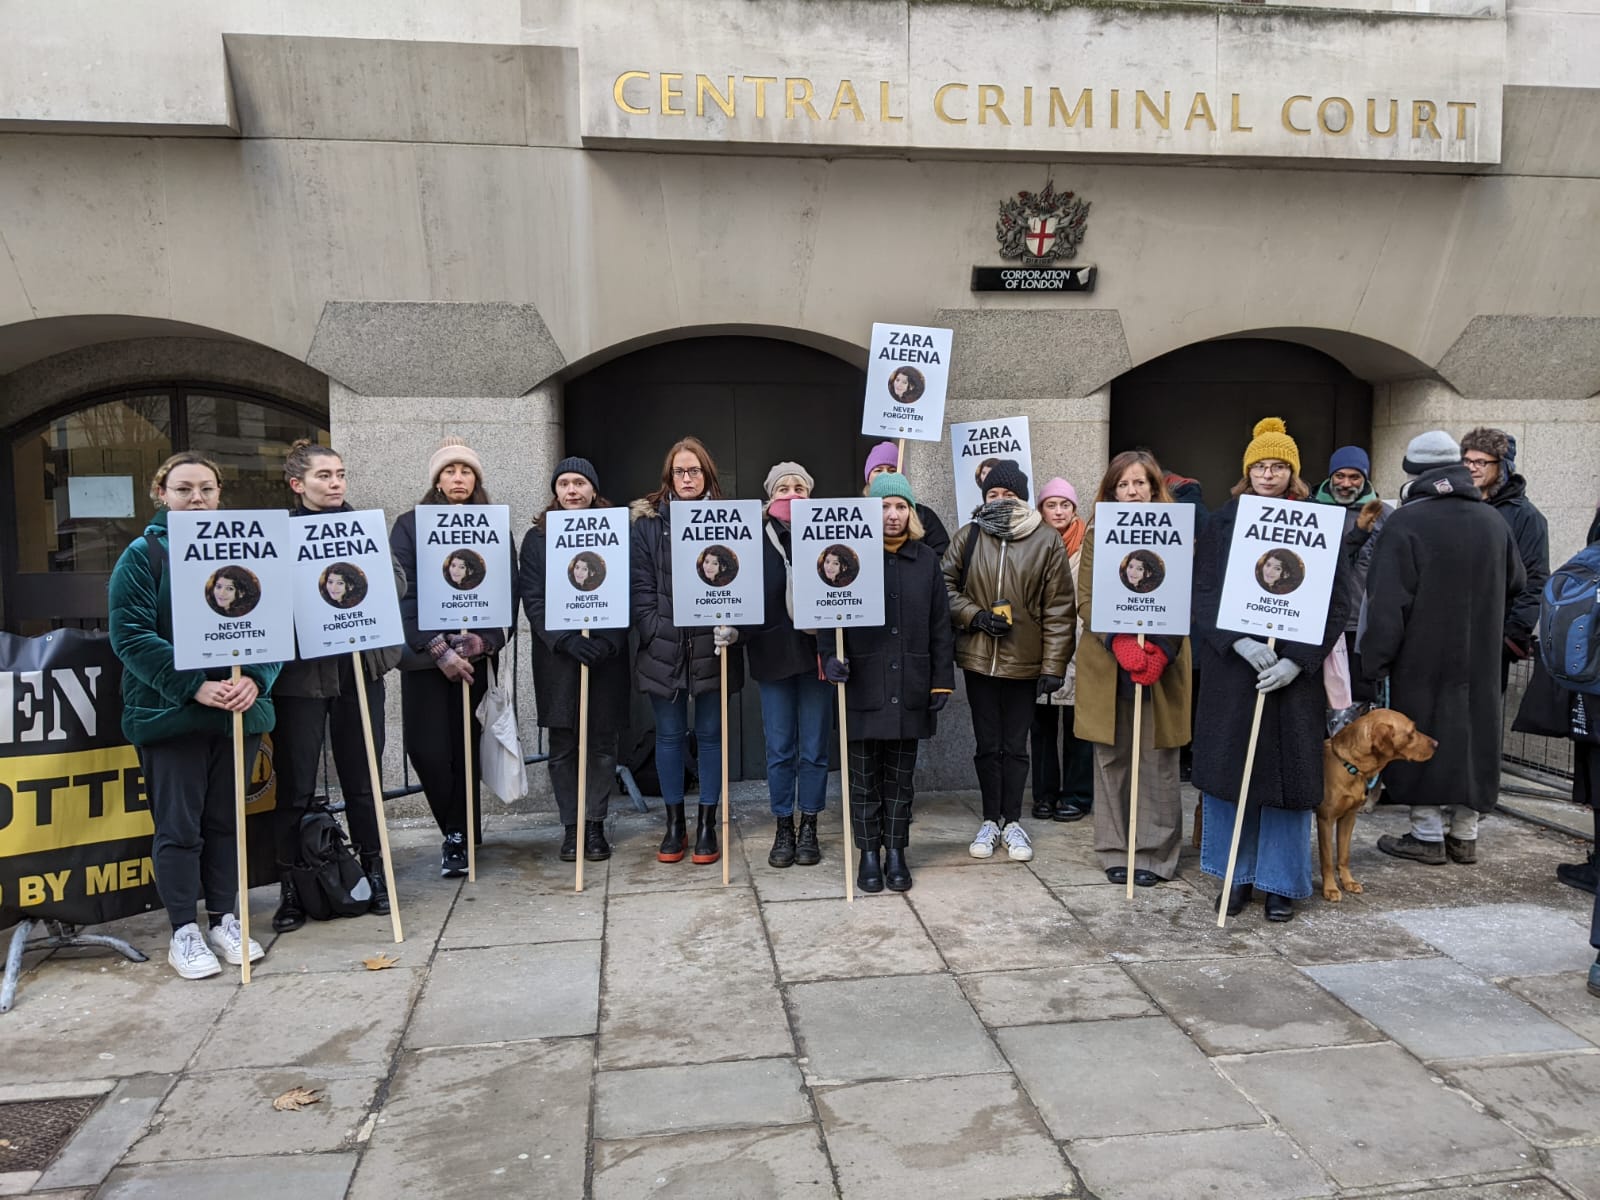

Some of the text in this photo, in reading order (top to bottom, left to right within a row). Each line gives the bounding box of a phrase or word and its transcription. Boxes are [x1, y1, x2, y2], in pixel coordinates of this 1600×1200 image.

[613, 71, 1477, 140] CENTRAL CRIMINAL COURT
[1001, 270, 1070, 280] CORPORATION
[1005, 280, 1063, 289] OF LONDON
[889, 332, 934, 348] ZARA
[878, 347, 940, 364] ALEENA
[883, 412, 924, 421] FORGOTTEN
[968, 425, 1012, 441] ZARA
[961, 439, 1022, 457] ALEENA
[437, 514, 489, 527] ZARA
[691, 509, 742, 523] ZARA
[812, 507, 863, 522] ZARA
[1117, 512, 1172, 527] ZARA
[1259, 506, 1319, 529] ZARA
[197, 521, 264, 539] ZARA
[304, 521, 365, 541] ZARA
[564, 517, 610, 532] ZARA
[428, 531, 499, 544] ALEENA
[682, 526, 752, 541] ALEENA
[802, 525, 873, 540] ALEENA
[1106, 530, 1182, 545] ALEENA
[1244, 524, 1327, 549] ALEENA
[556, 533, 619, 548] ALEENA
[184, 542, 277, 561] ALEENA
[297, 538, 379, 561] ALEENA
[695, 597, 742, 605] FORGOTTEN
[706, 590, 731, 598] NEVER
[1127, 597, 1155, 605] NEVER
[1259, 596, 1290, 607] NEVER
[441, 601, 489, 609] FORGOTTEN
[566, 601, 608, 610] FORGOTTEN
[1115, 604, 1166, 612] FORGOTTEN
[1246, 602, 1300, 618] FORGOTTEN
[334, 611, 363, 621] NEVER
[218, 621, 252, 631] NEVER
[323, 617, 376, 631] FORGOTTEN
[205, 630, 265, 641] FORGOTTEN
[0, 666, 101, 743] EN
[0, 767, 150, 830] TTE
[19, 870, 71, 907] BY
